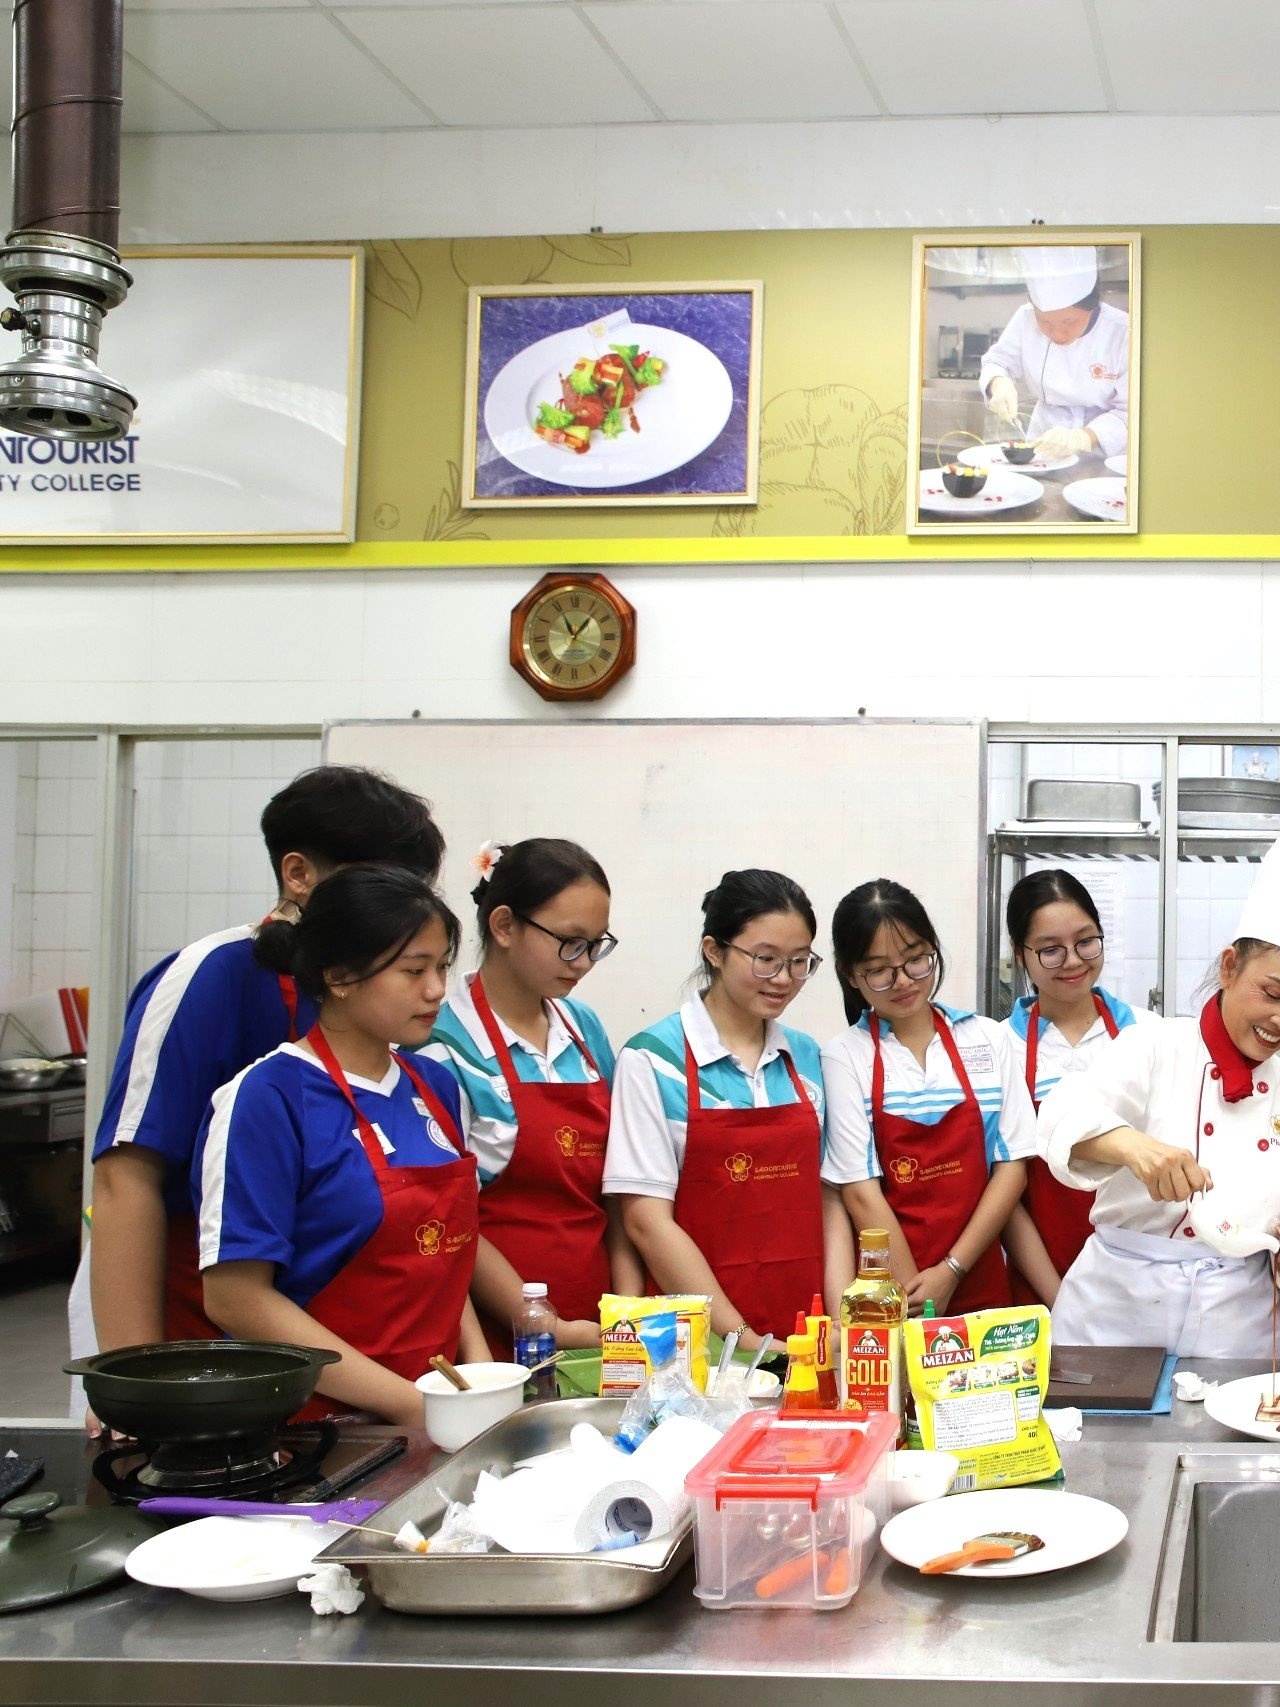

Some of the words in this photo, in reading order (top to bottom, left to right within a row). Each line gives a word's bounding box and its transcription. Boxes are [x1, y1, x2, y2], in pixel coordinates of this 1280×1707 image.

[31, 474, 140, 491] COLLEGE
[853, 1347, 886, 1355] MEIZAN
[923, 1349, 974, 1368] MEIZAN
[846, 1358, 892, 1386] GOLD
